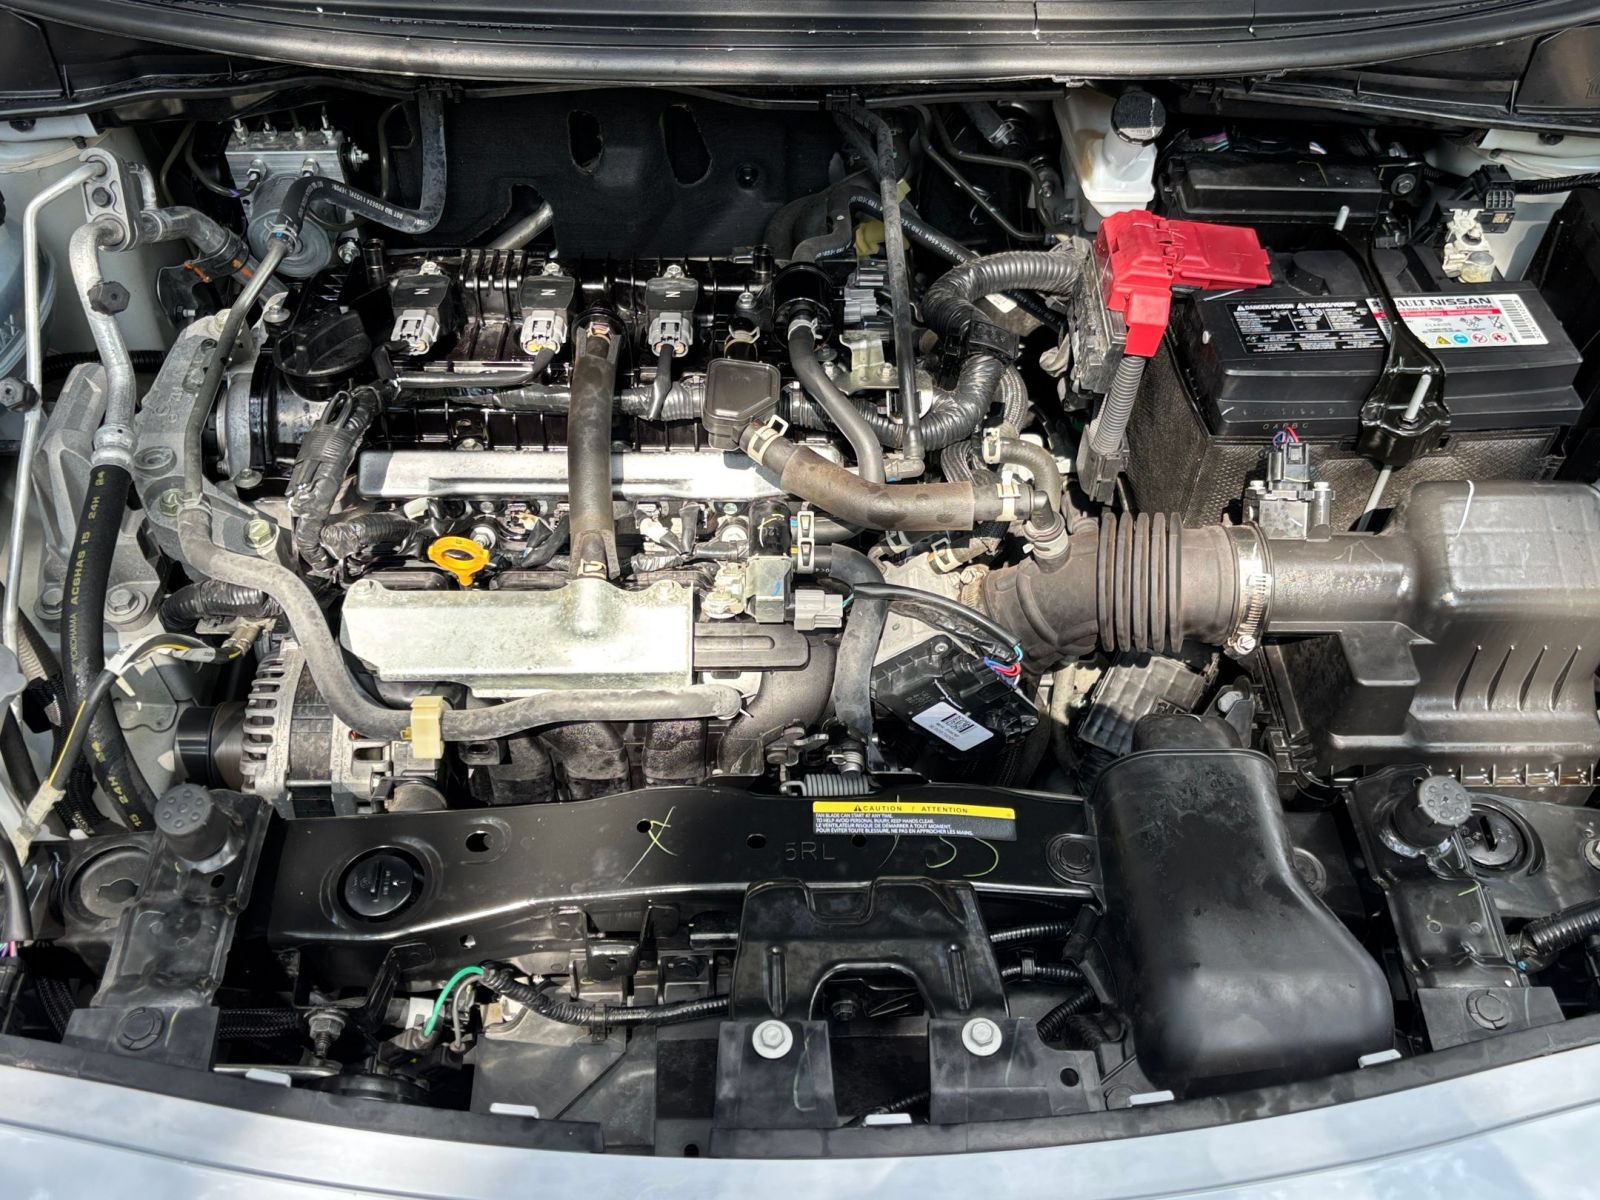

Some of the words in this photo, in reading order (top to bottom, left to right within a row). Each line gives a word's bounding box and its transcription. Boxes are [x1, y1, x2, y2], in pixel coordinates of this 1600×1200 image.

[1429, 297, 1492, 306] NISSAN
[69, 612, 79, 662] YOKOHAMA
[921, 806, 968, 814] ATTENTION
